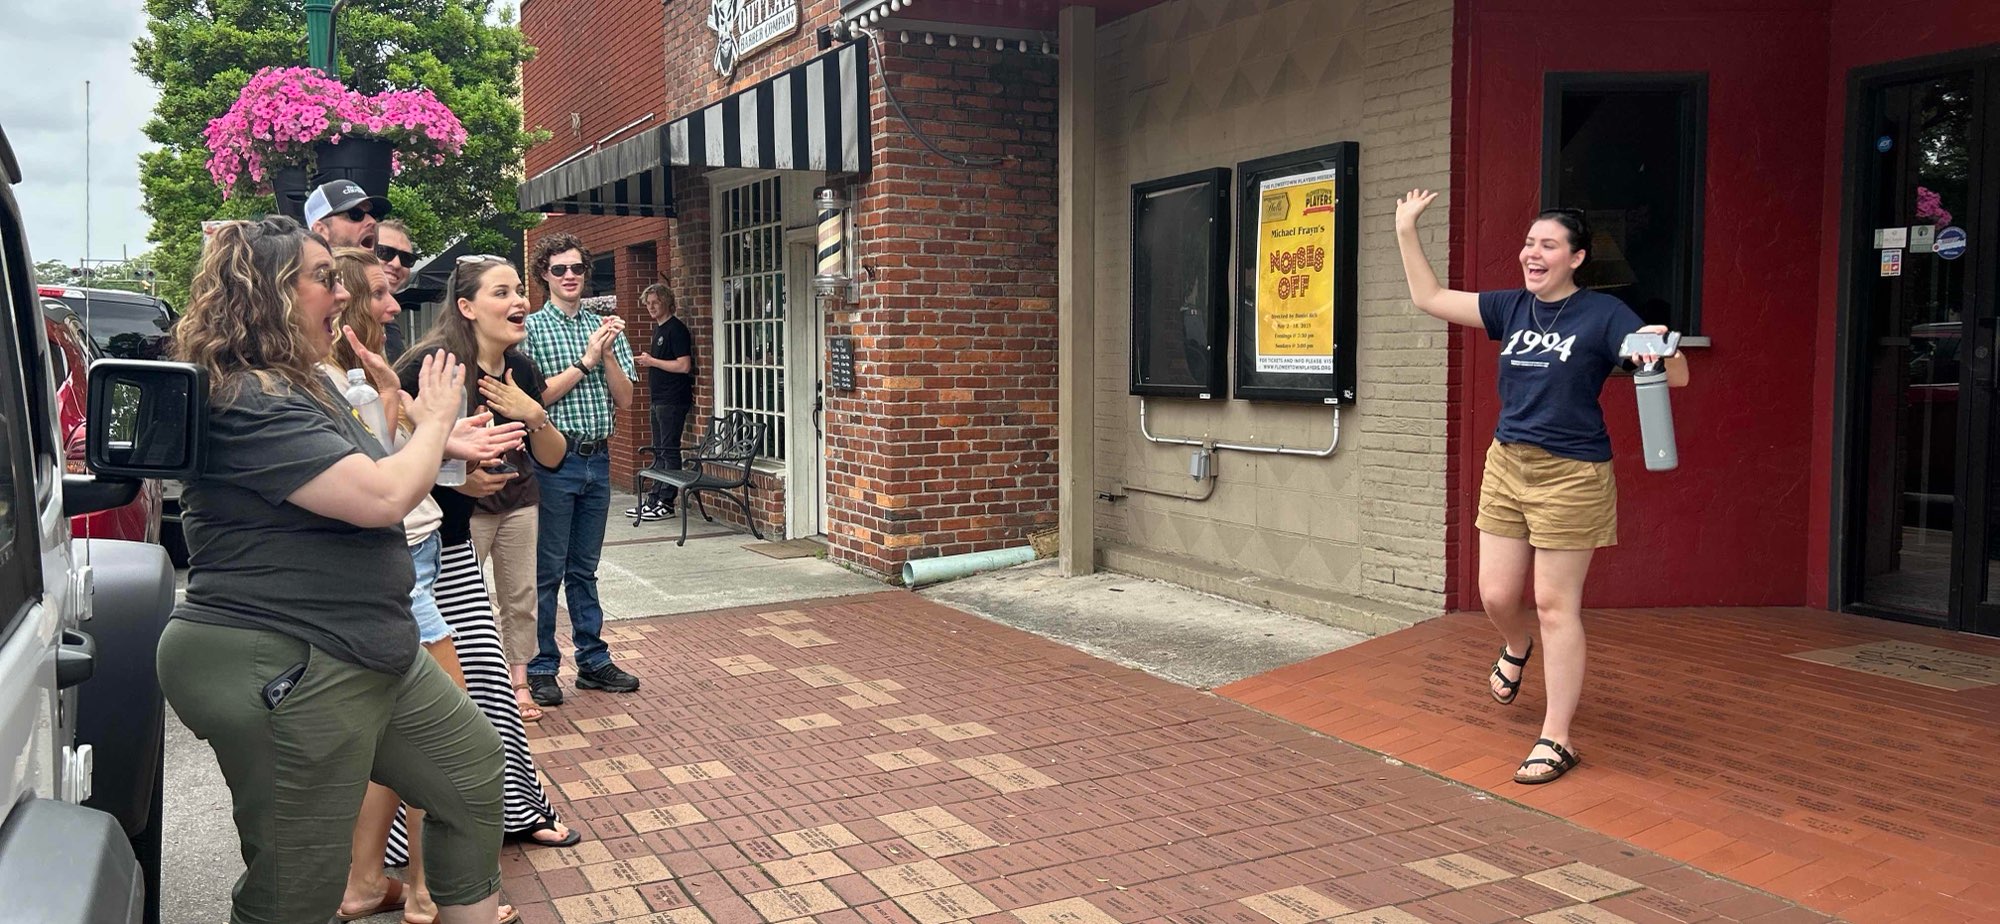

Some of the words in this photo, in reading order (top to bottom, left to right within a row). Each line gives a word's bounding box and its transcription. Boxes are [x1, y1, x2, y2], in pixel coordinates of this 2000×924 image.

[740, 27, 763, 51] BARBER
[764, 10, 795, 38] COMPANY
[1297, 176, 1316, 184] PLAYERS
[1306, 194, 1332, 207] PLAYERS
[1271, 228, 1296, 238] Michael
[1298, 225, 1325, 236] Frayn's
[1270, 245, 1325, 274] NOISES
[1278, 274, 1310, 300] OFF
[1501, 329, 1576, 362] 1994
